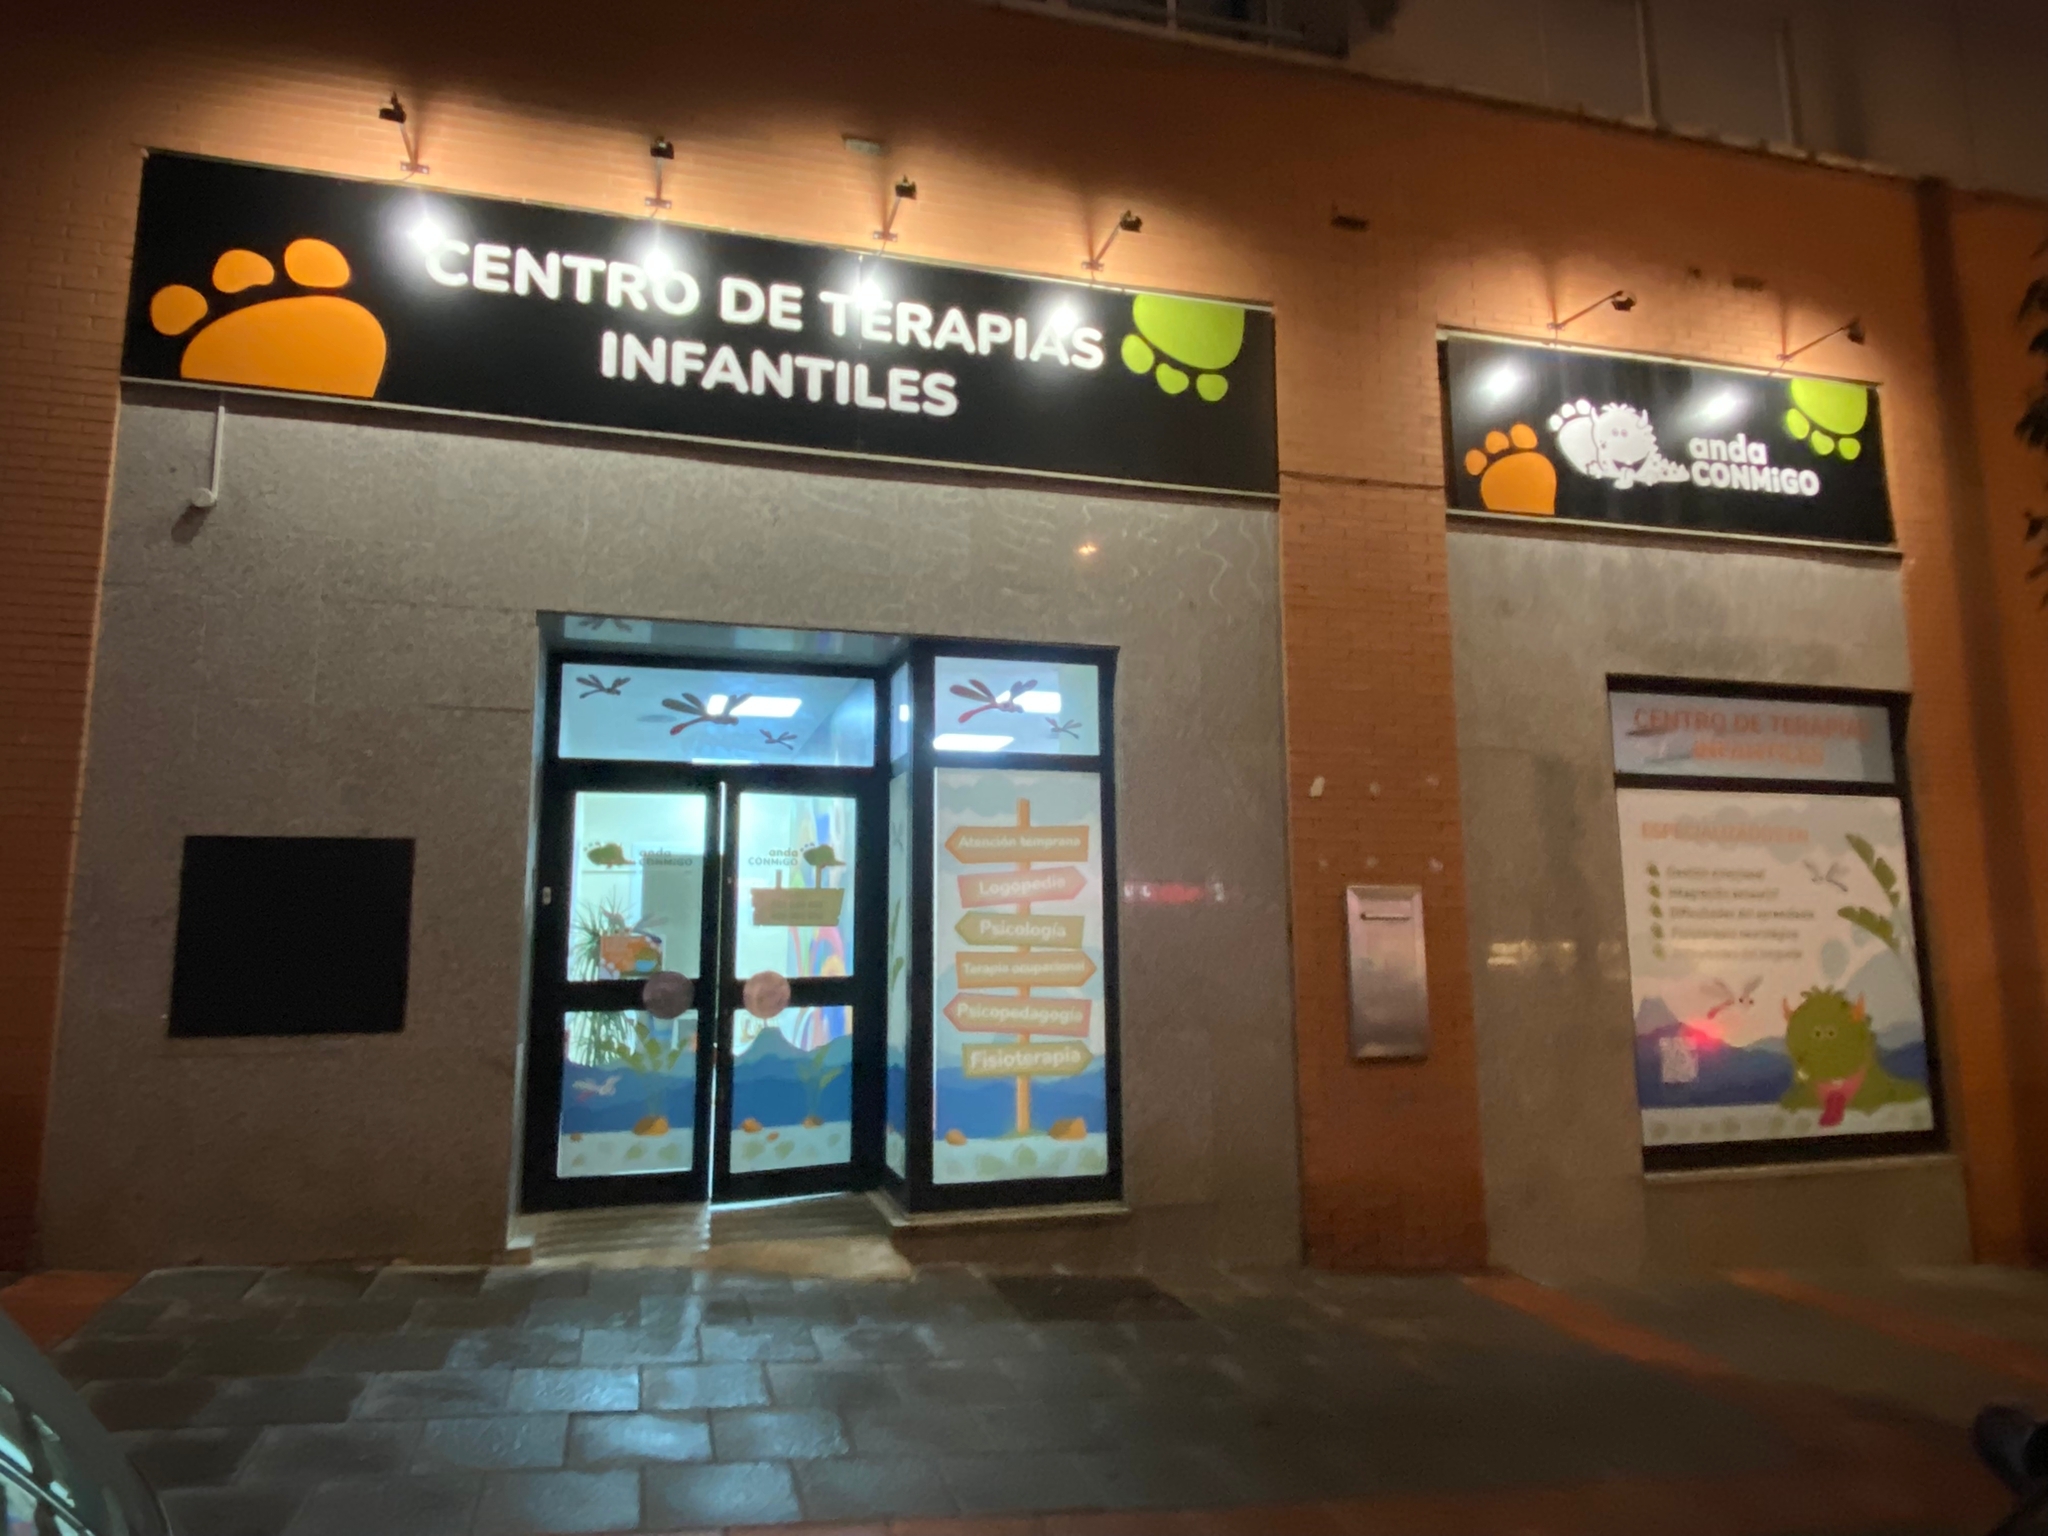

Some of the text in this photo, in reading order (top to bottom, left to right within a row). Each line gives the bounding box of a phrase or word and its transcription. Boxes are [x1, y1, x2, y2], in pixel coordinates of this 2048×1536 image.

[425, 237, 1103, 370] CENTRO DE TERAPIAS
[601, 330, 958, 418] INFANTILES
[1689, 432, 1767, 465] anda
[978, 875, 1066, 896] Logopedia
[980, 919, 1066, 940] Psicología
[970, 1046, 1081, 1069] Fisioterapia
